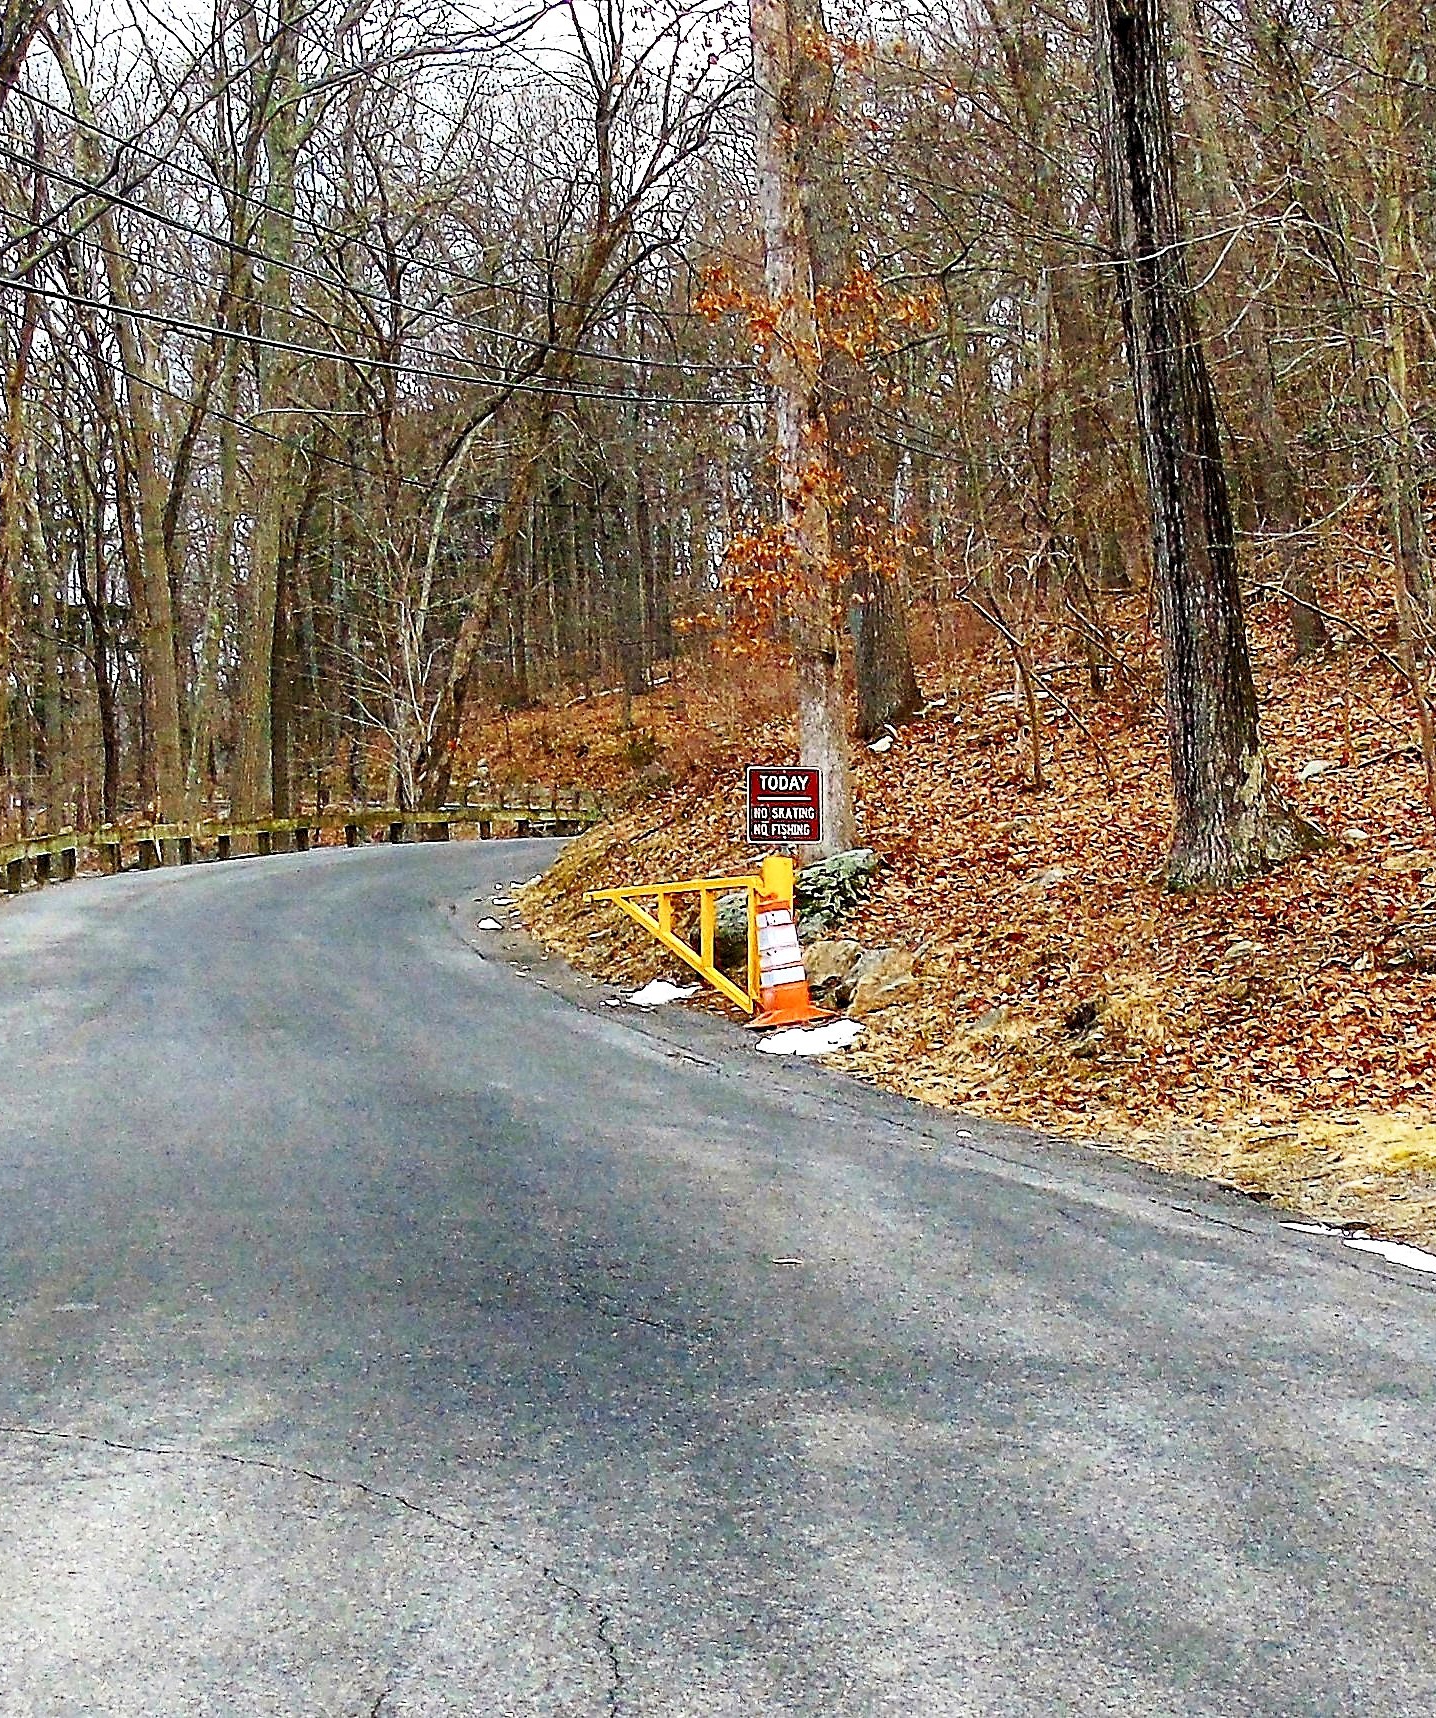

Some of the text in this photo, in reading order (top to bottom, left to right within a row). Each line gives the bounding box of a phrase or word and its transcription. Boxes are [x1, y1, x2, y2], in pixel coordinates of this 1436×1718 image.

[759, 774, 809, 791] TODAY
[753, 807, 815, 820] NO SKATING
[753, 823, 810, 836] NO FISHING
